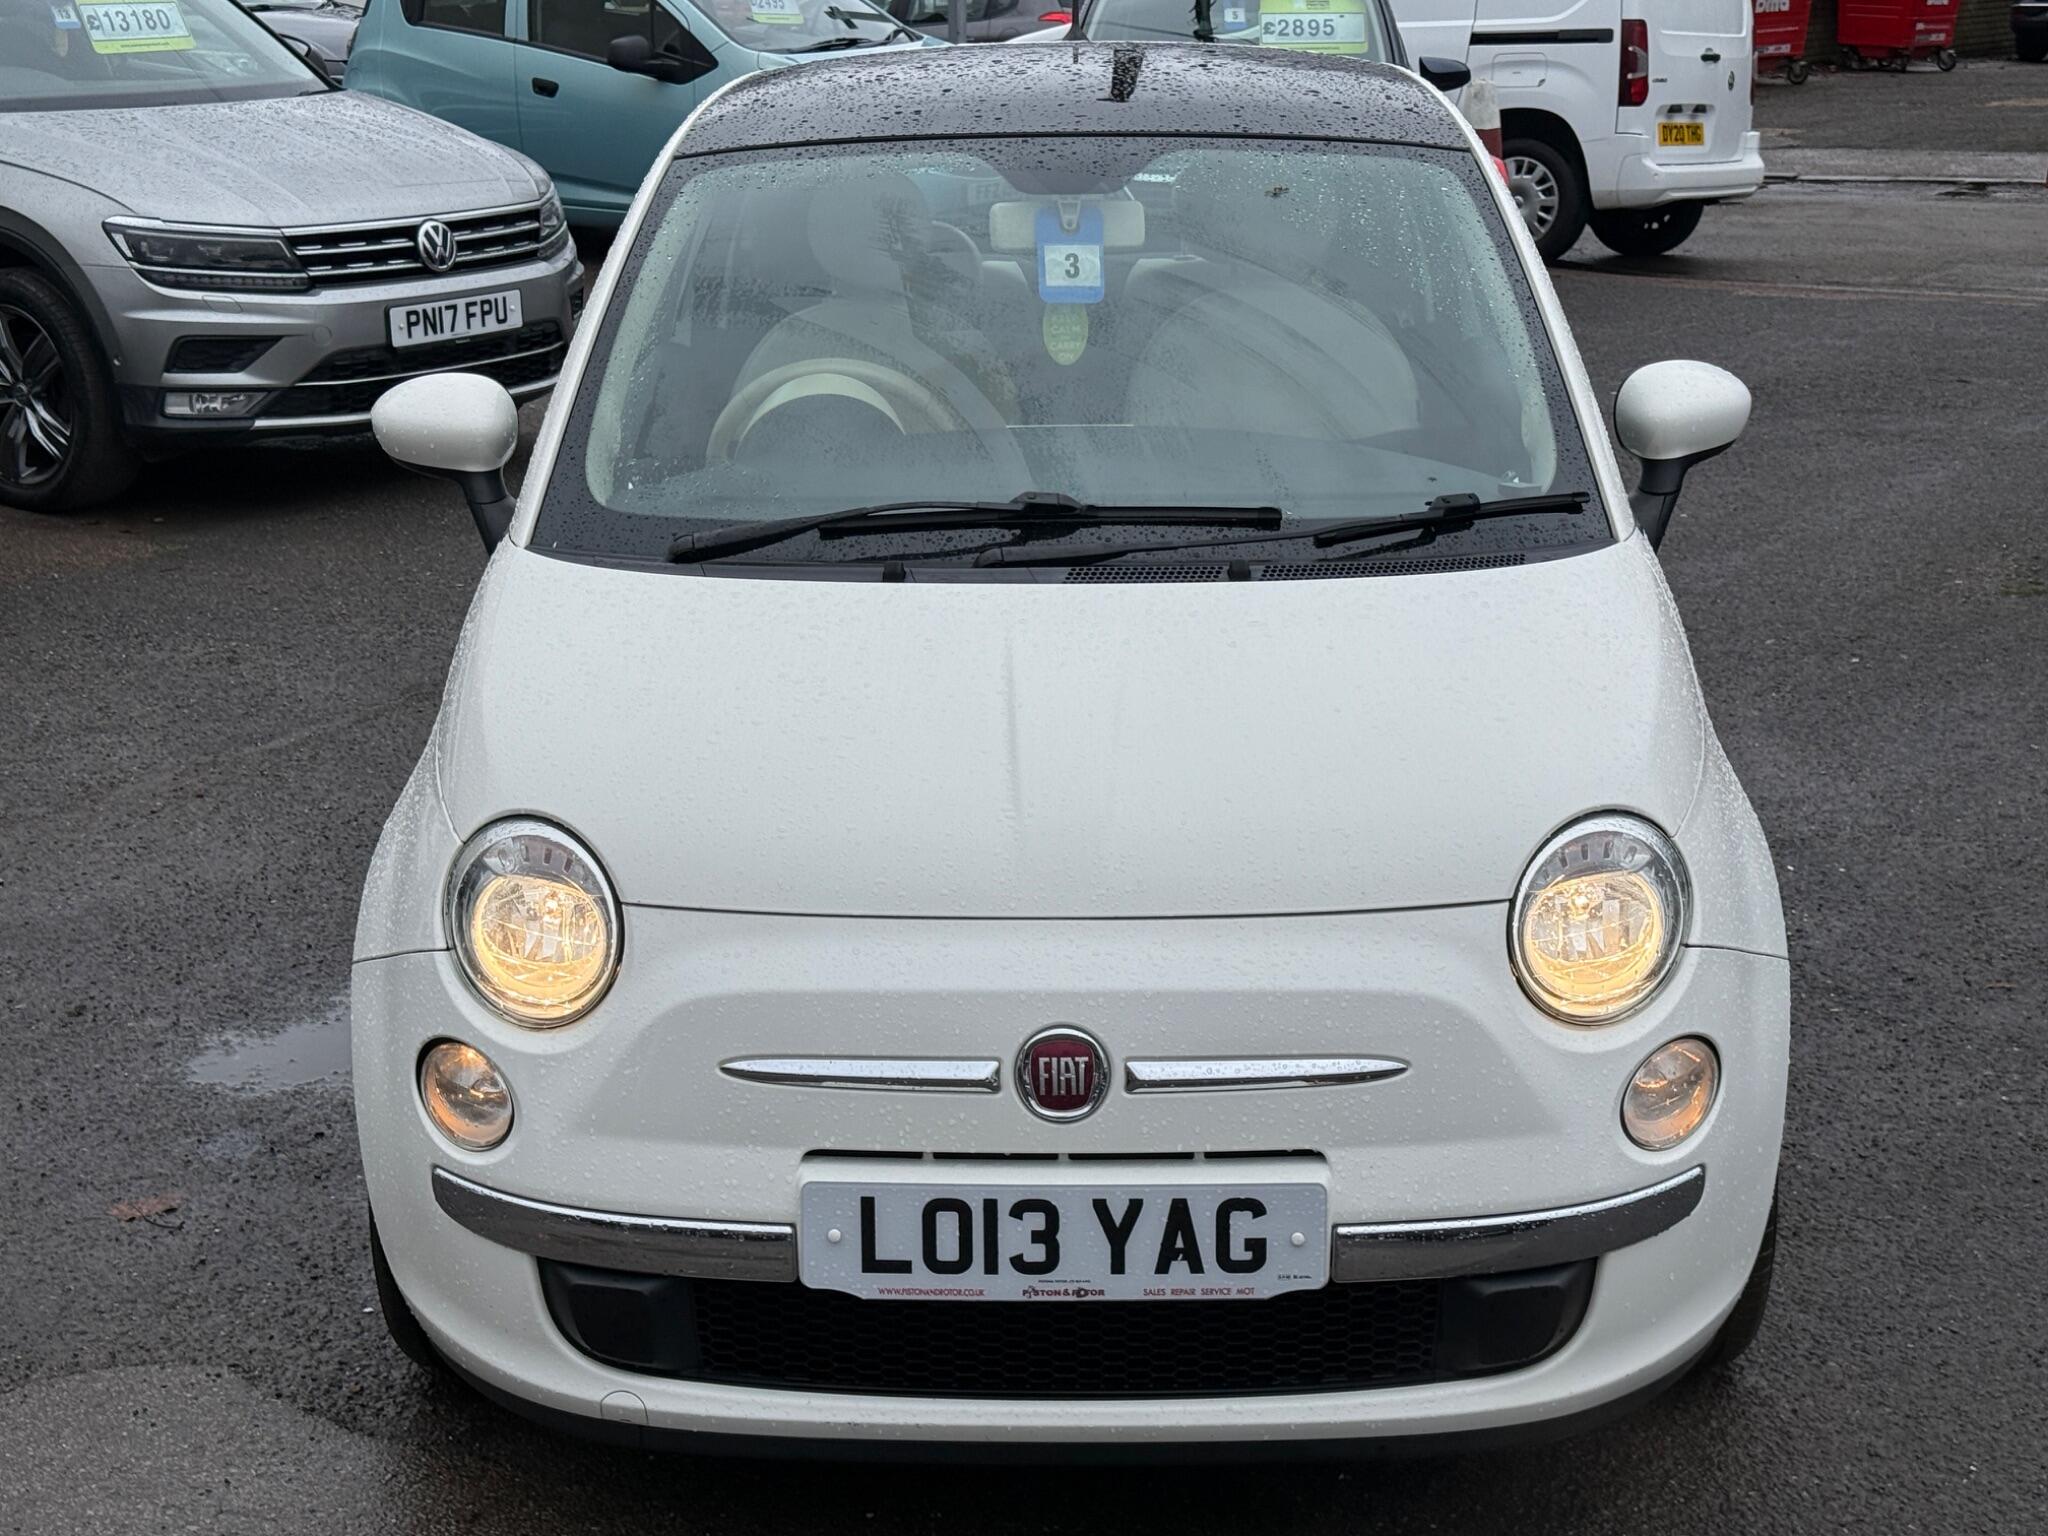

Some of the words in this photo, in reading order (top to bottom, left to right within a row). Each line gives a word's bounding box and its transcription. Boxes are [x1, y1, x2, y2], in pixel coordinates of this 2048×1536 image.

[1263, 19, 1335, 37] £2895
[1064, 253, 1080, 279] 3
[405, 304, 458, 339] PN17
[465, 296, 508, 330] FPU
[1038, 1056, 1089, 1096] FIAT
[860, 1196, 1060, 1275] LO13
[1092, 1197, 1268, 1275] YAG
[1143, 1288, 1166, 1296] SALES
[1170, 1288, 1196, 1296] REPAIR
[1201, 1288, 1231, 1296] SERVICE
[1236, 1287, 1255, 1295] MOT
